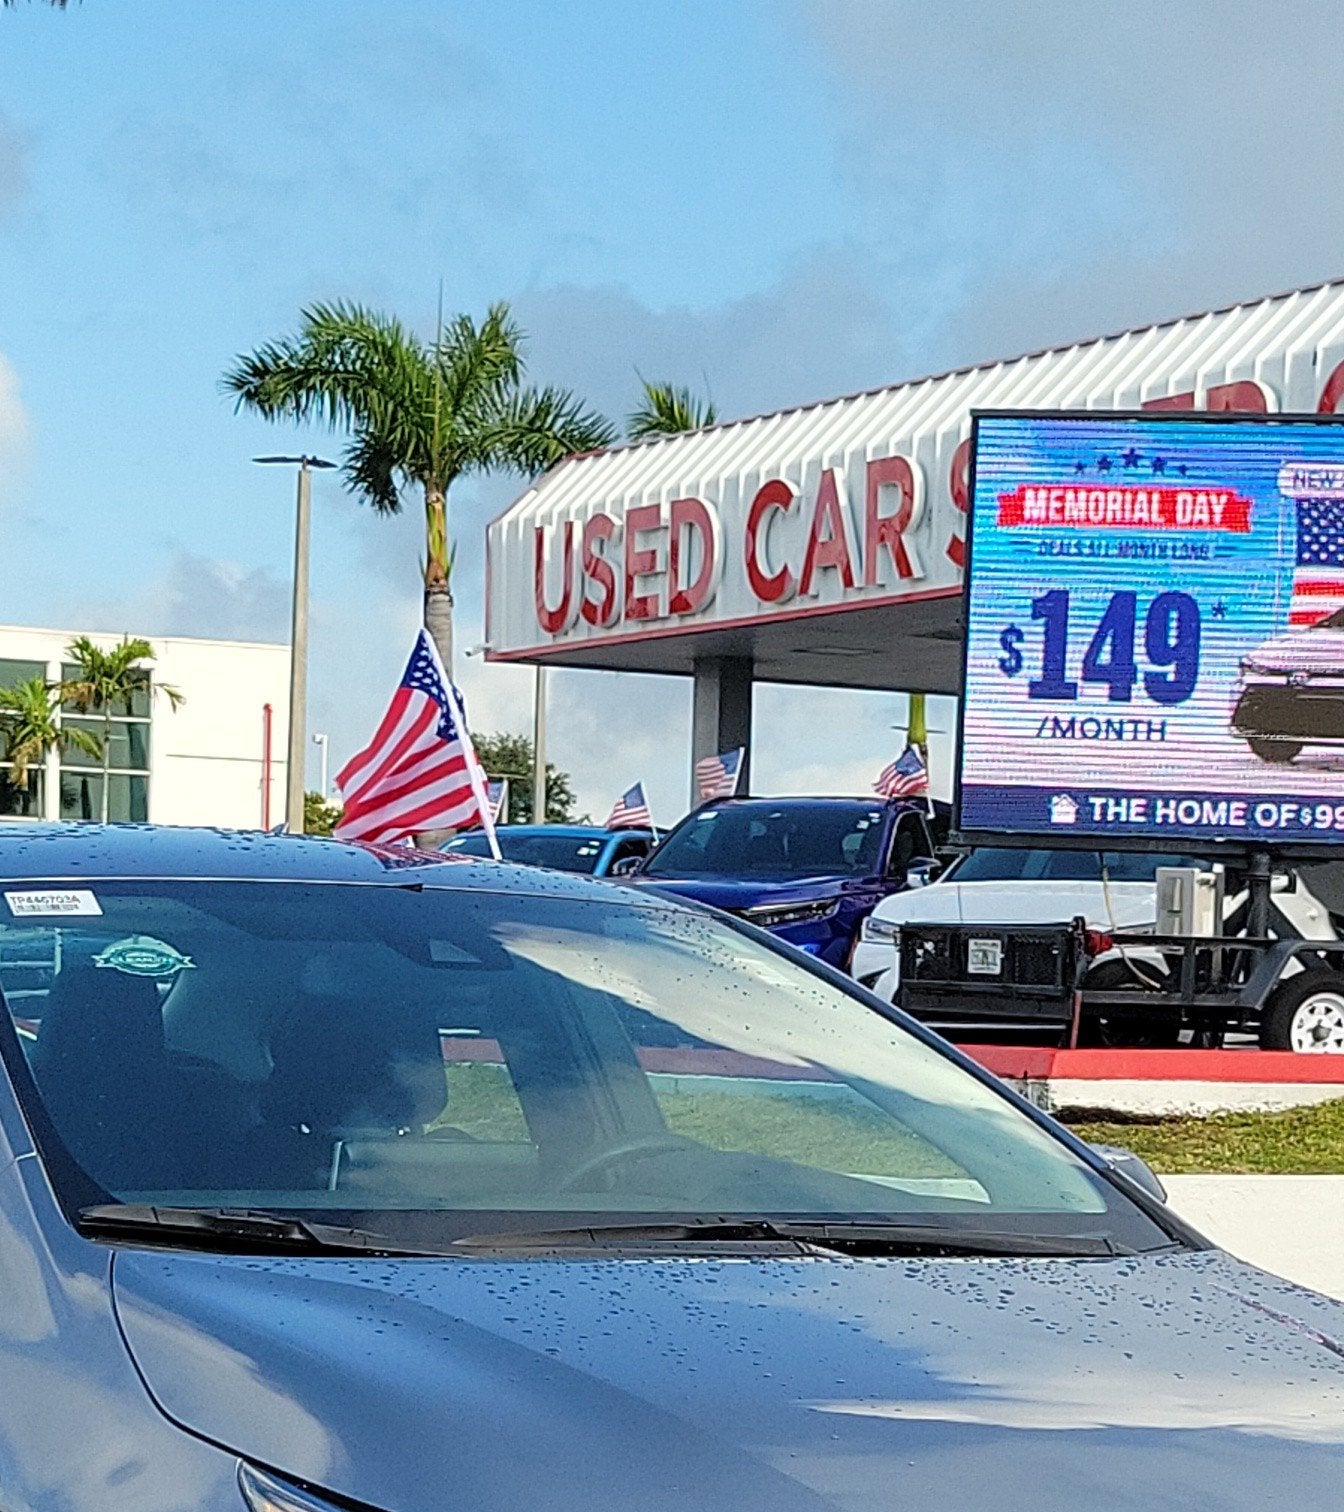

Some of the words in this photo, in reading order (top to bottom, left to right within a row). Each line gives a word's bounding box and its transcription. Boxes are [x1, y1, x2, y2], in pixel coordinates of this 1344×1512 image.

[1292, 470, 1336, 489] NEW
[1023, 488, 1165, 524] MEMORIAL
[1175, 491, 1228, 525] DAY
[534, 497, 724, 634] USED
[744, 455, 926, 603] CAR
[1035, 715, 1166, 742] /MONTH
[1089, 796, 1147, 823] THE
[1156, 800, 1246, 827] HOME
[1256, 803, 1298, 828] OF
